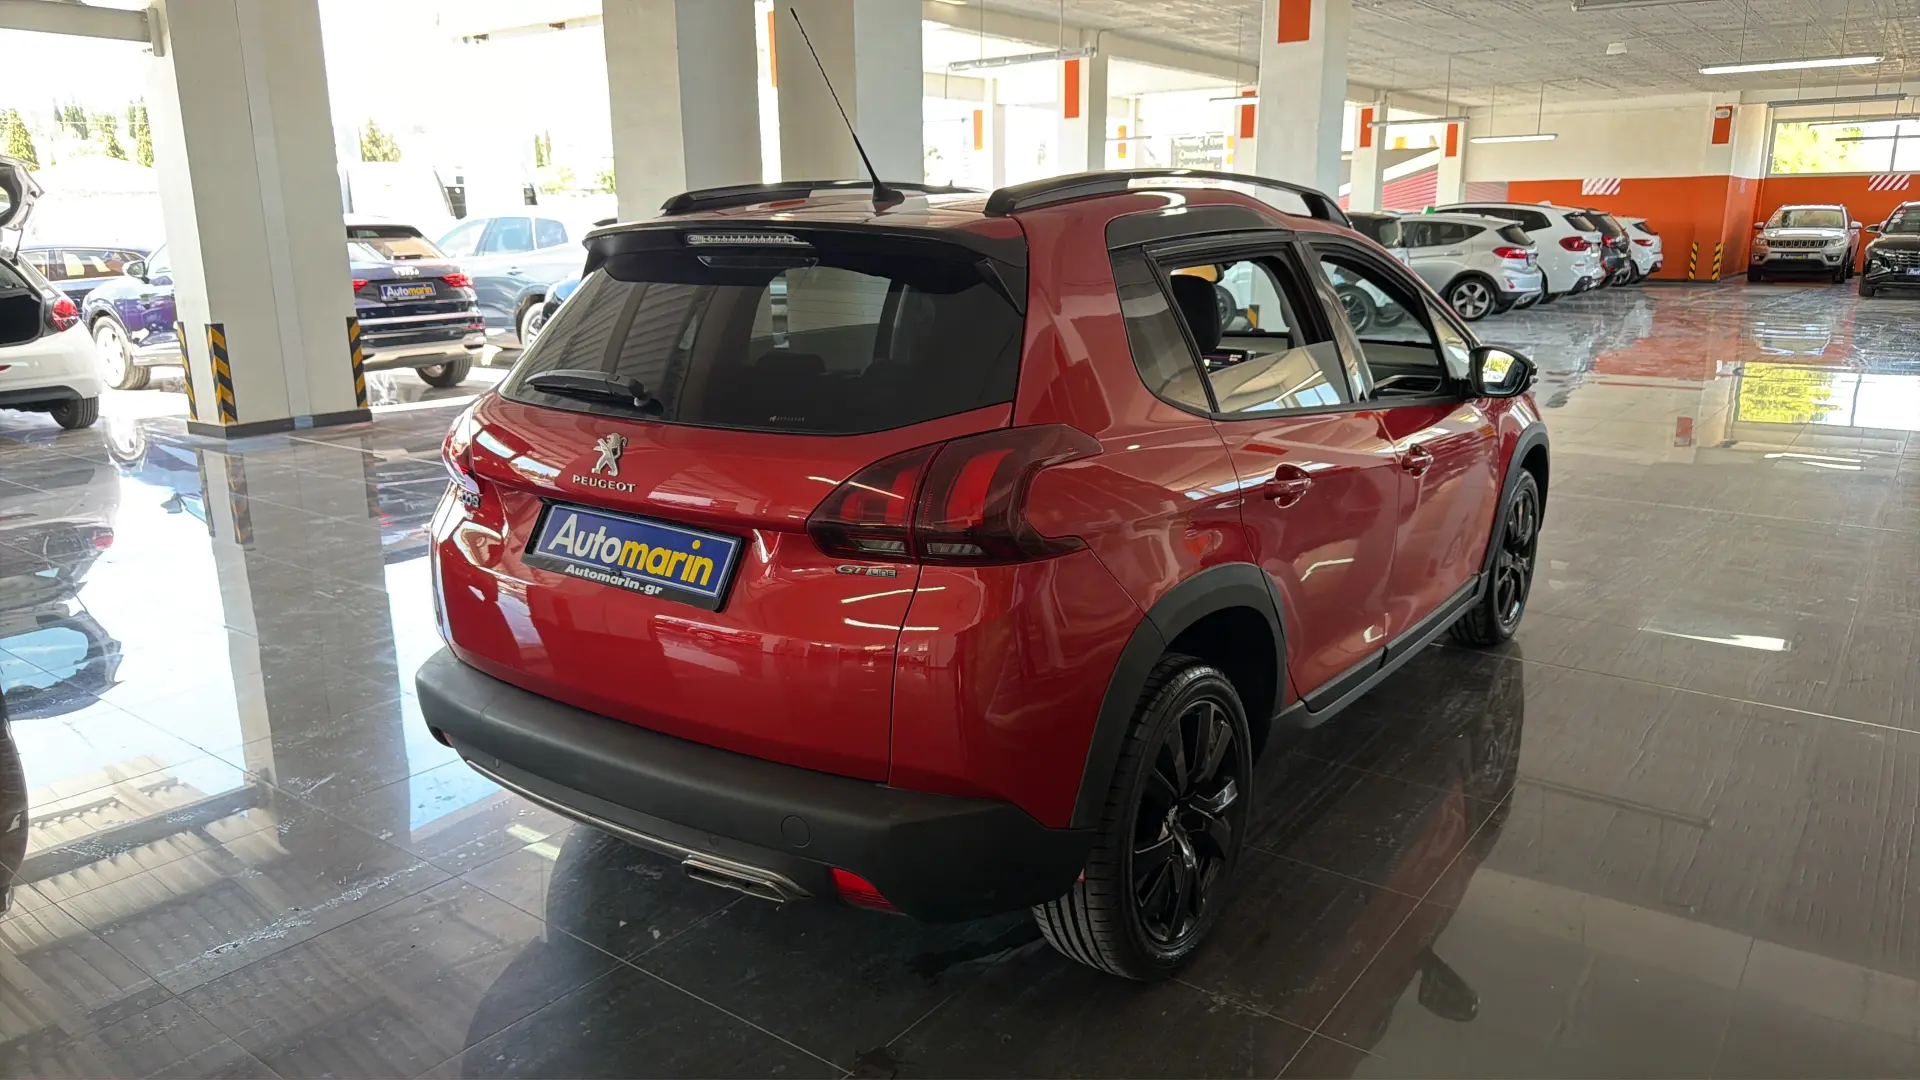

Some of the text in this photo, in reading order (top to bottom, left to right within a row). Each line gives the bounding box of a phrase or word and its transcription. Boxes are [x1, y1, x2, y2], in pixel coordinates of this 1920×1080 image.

[572, 474, 636, 493] PEUGEOT
[547, 513, 714, 587] Automarin
[564, 564, 664, 595] Automarin.gr
[836, 564, 895, 577] GT LINE
